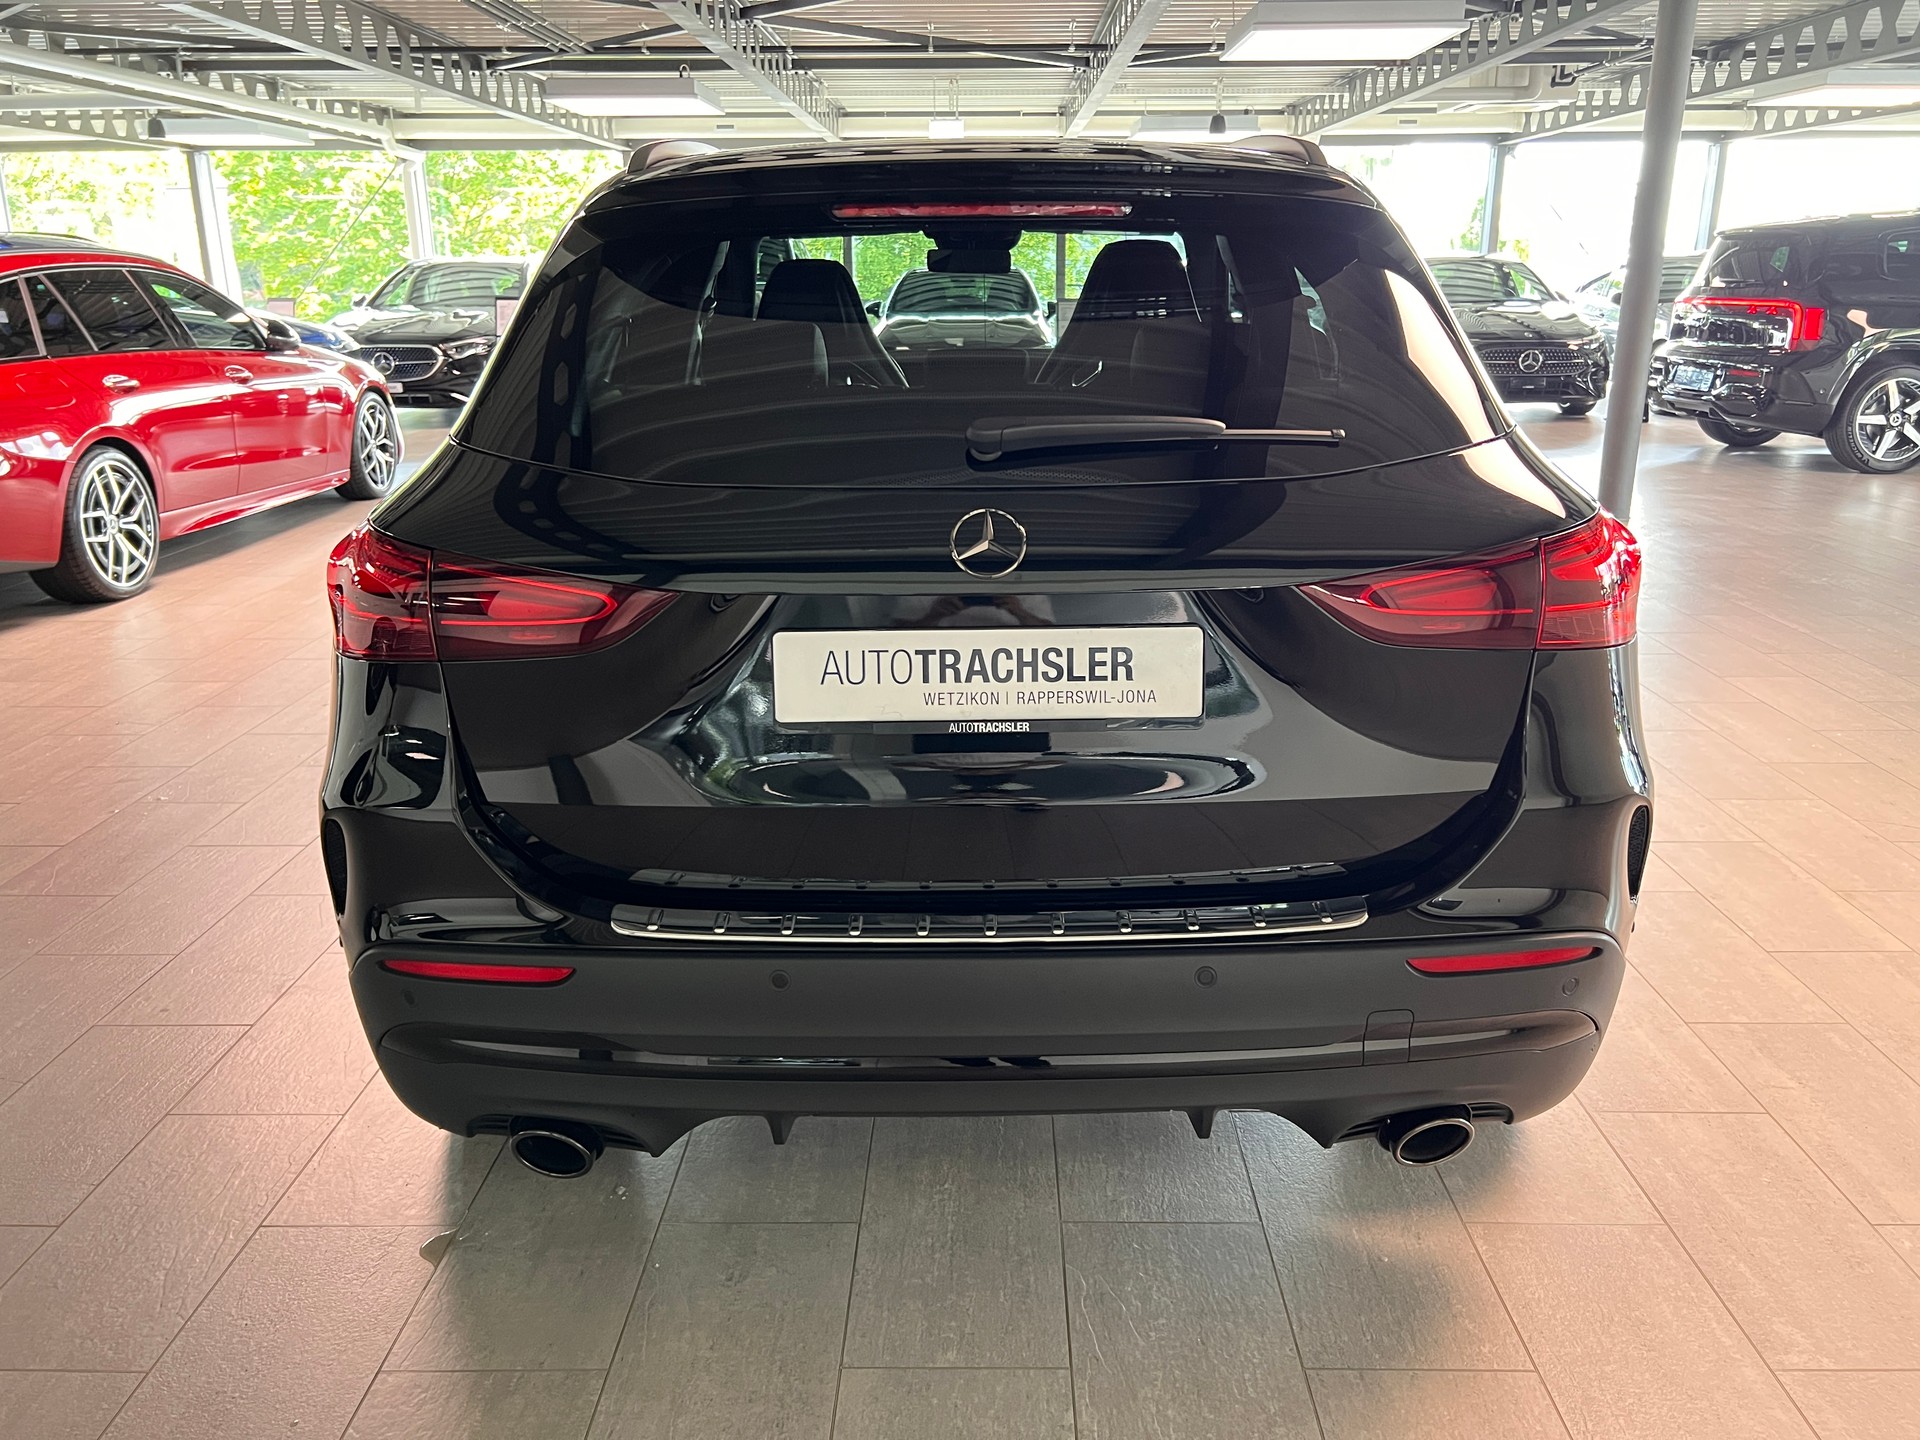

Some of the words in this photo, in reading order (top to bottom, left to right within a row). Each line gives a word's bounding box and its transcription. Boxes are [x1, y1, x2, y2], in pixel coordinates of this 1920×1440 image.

[819, 646, 1135, 687] AUTOTRACHSLER
[923, 691, 1000, 706] WETZIKON
[1016, 689, 1157, 705] RAPPERSWIL-JONA
[948, 721, 1031, 734] AUTOTRACHSLER
